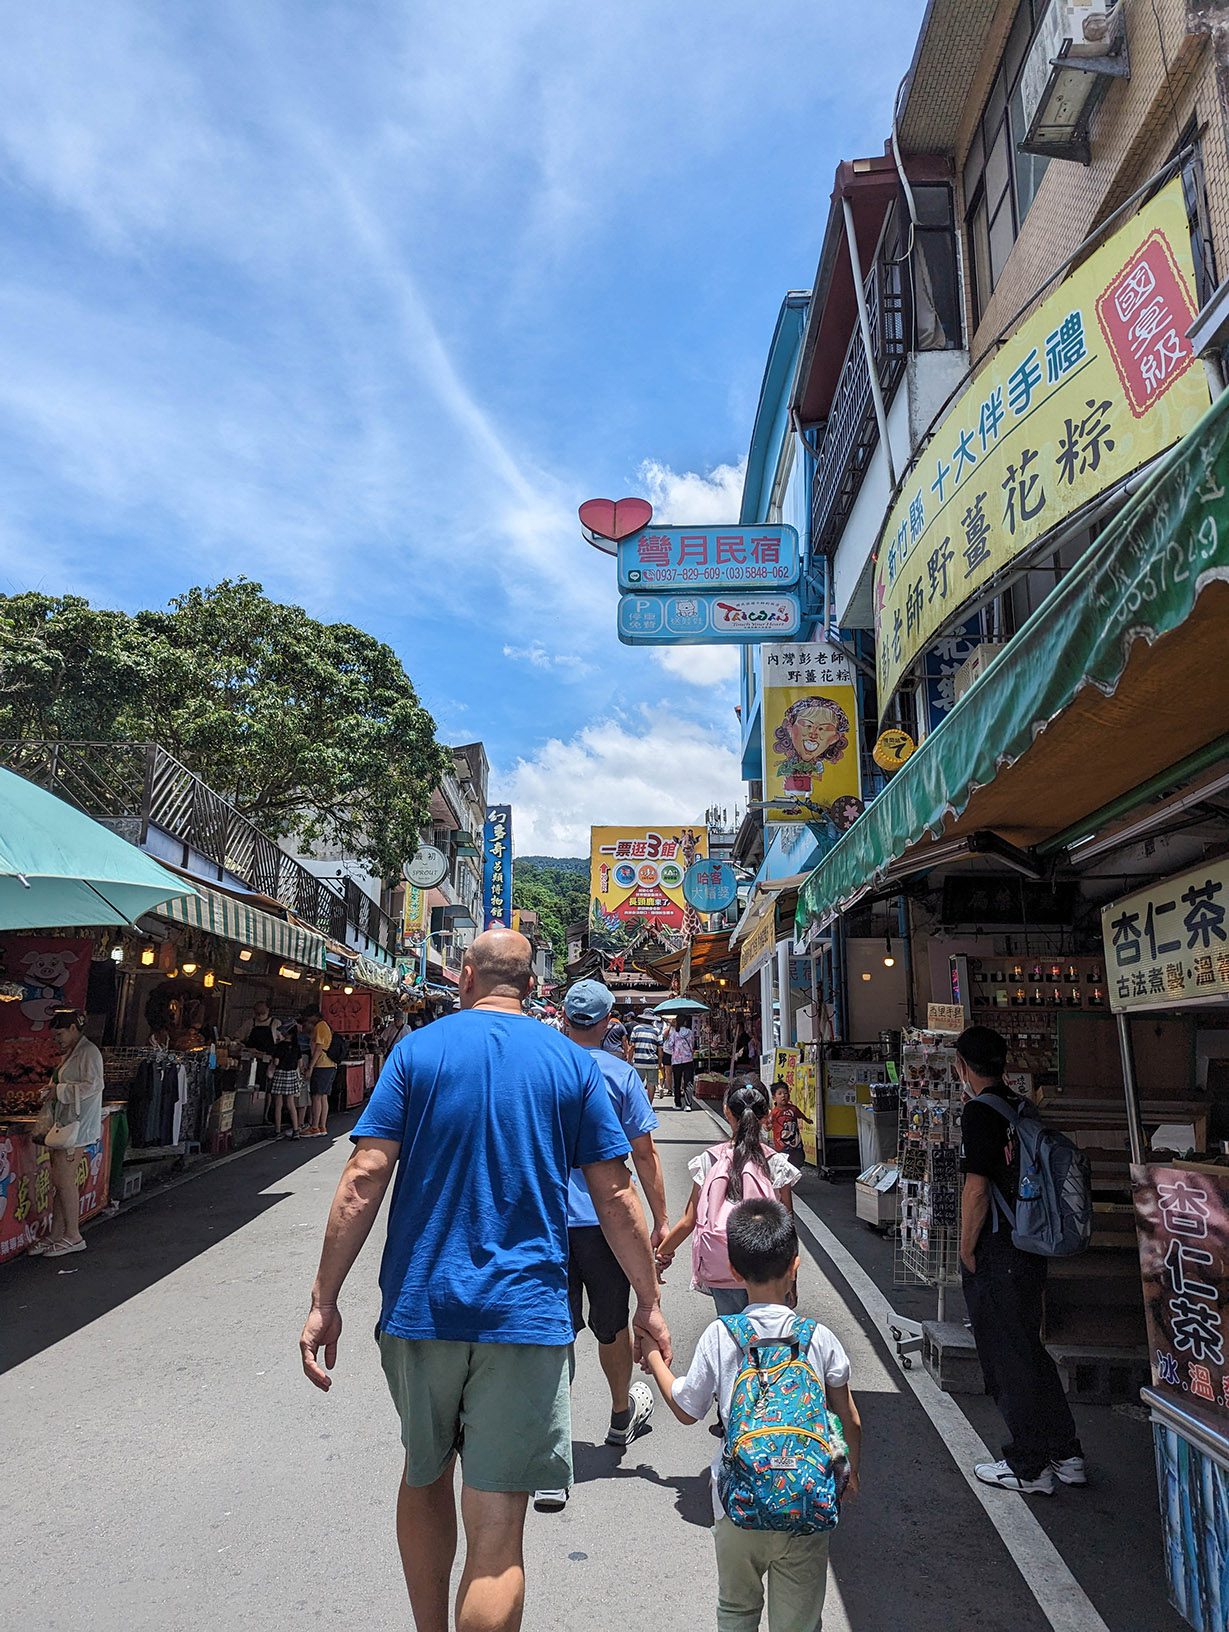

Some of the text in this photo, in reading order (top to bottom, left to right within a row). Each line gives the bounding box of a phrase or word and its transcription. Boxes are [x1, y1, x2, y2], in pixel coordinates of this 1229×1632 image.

[1114, 260, 1187, 394] 國宴級
[637, 535, 781, 567] 彎月民宿
[767, 652, 844, 666] 內灣彭老師
[788, 669, 851, 683] 野薑花粽
[601, 833, 677, 859] 一票逛3館
[1111, 879, 1228, 967] 杏仁茶
[1157, 1181, 1225, 1366] 杏仁茶
